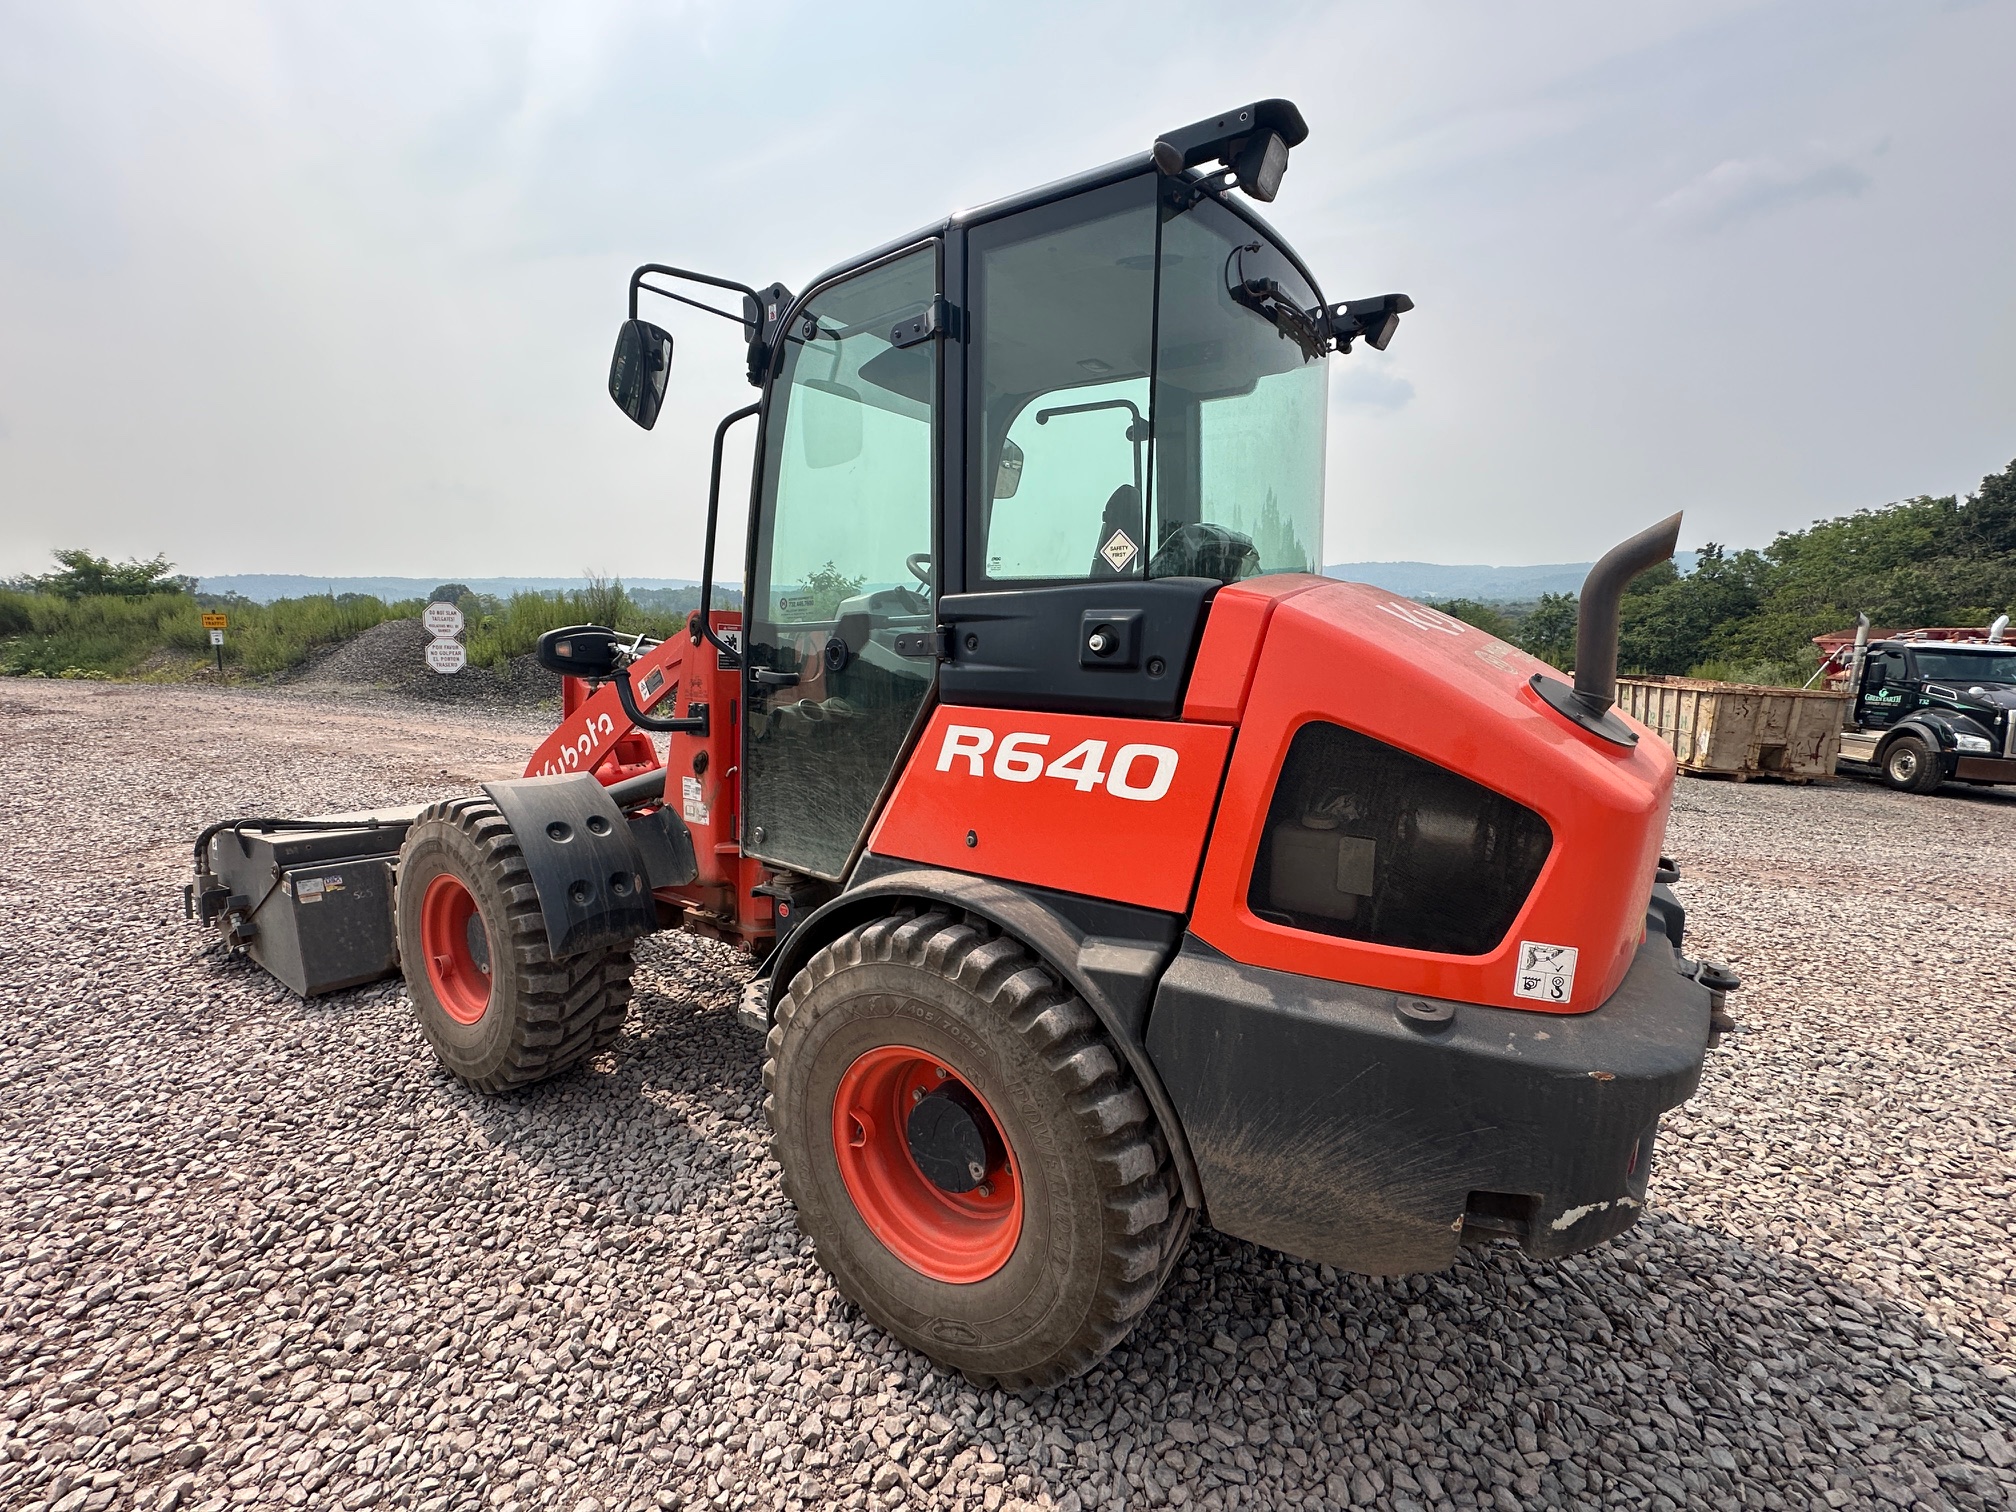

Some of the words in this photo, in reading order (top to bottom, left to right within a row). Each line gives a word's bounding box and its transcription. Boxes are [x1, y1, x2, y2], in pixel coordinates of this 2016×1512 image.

[1864, 693, 1882, 702] GREEN
[1883, 695, 1902, 703] EARTH
[935, 724, 1179, 802] R640
[908, 1005, 987, 1058] 405/70R18
[1005, 1080, 1072, 1275] POWERLOAD
